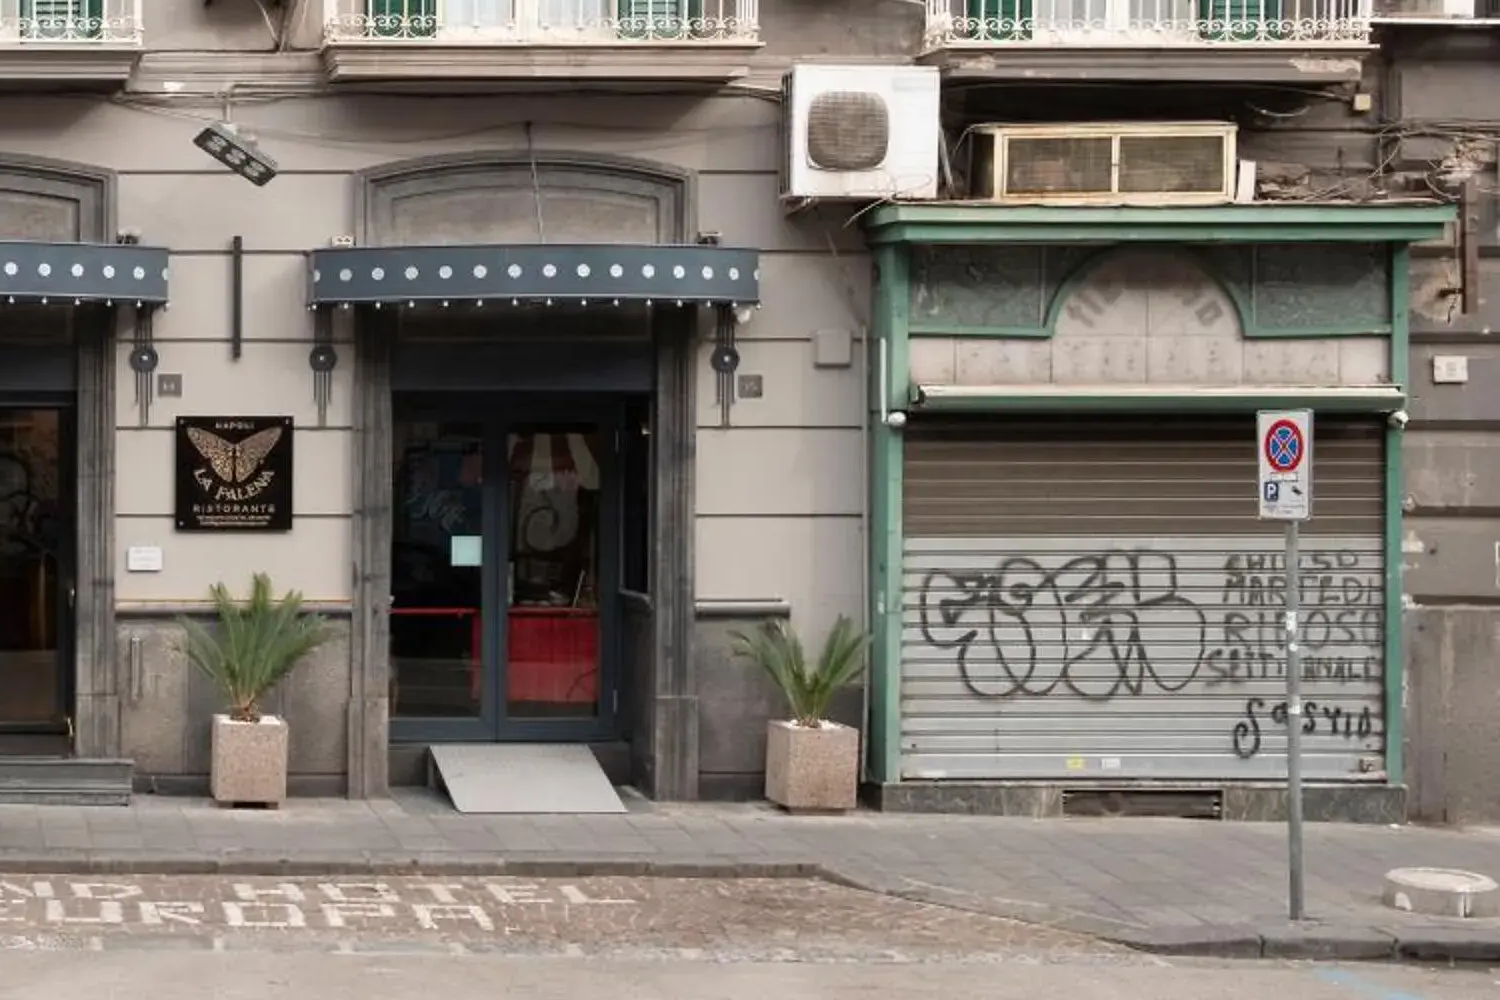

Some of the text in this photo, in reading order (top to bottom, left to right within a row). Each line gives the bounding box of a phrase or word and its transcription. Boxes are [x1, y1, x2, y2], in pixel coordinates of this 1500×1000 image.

[193, 469, 213, 492] LA
[192, 504, 276, 513] RISTORANTE
[231, 882, 637, 904] HOTEL
